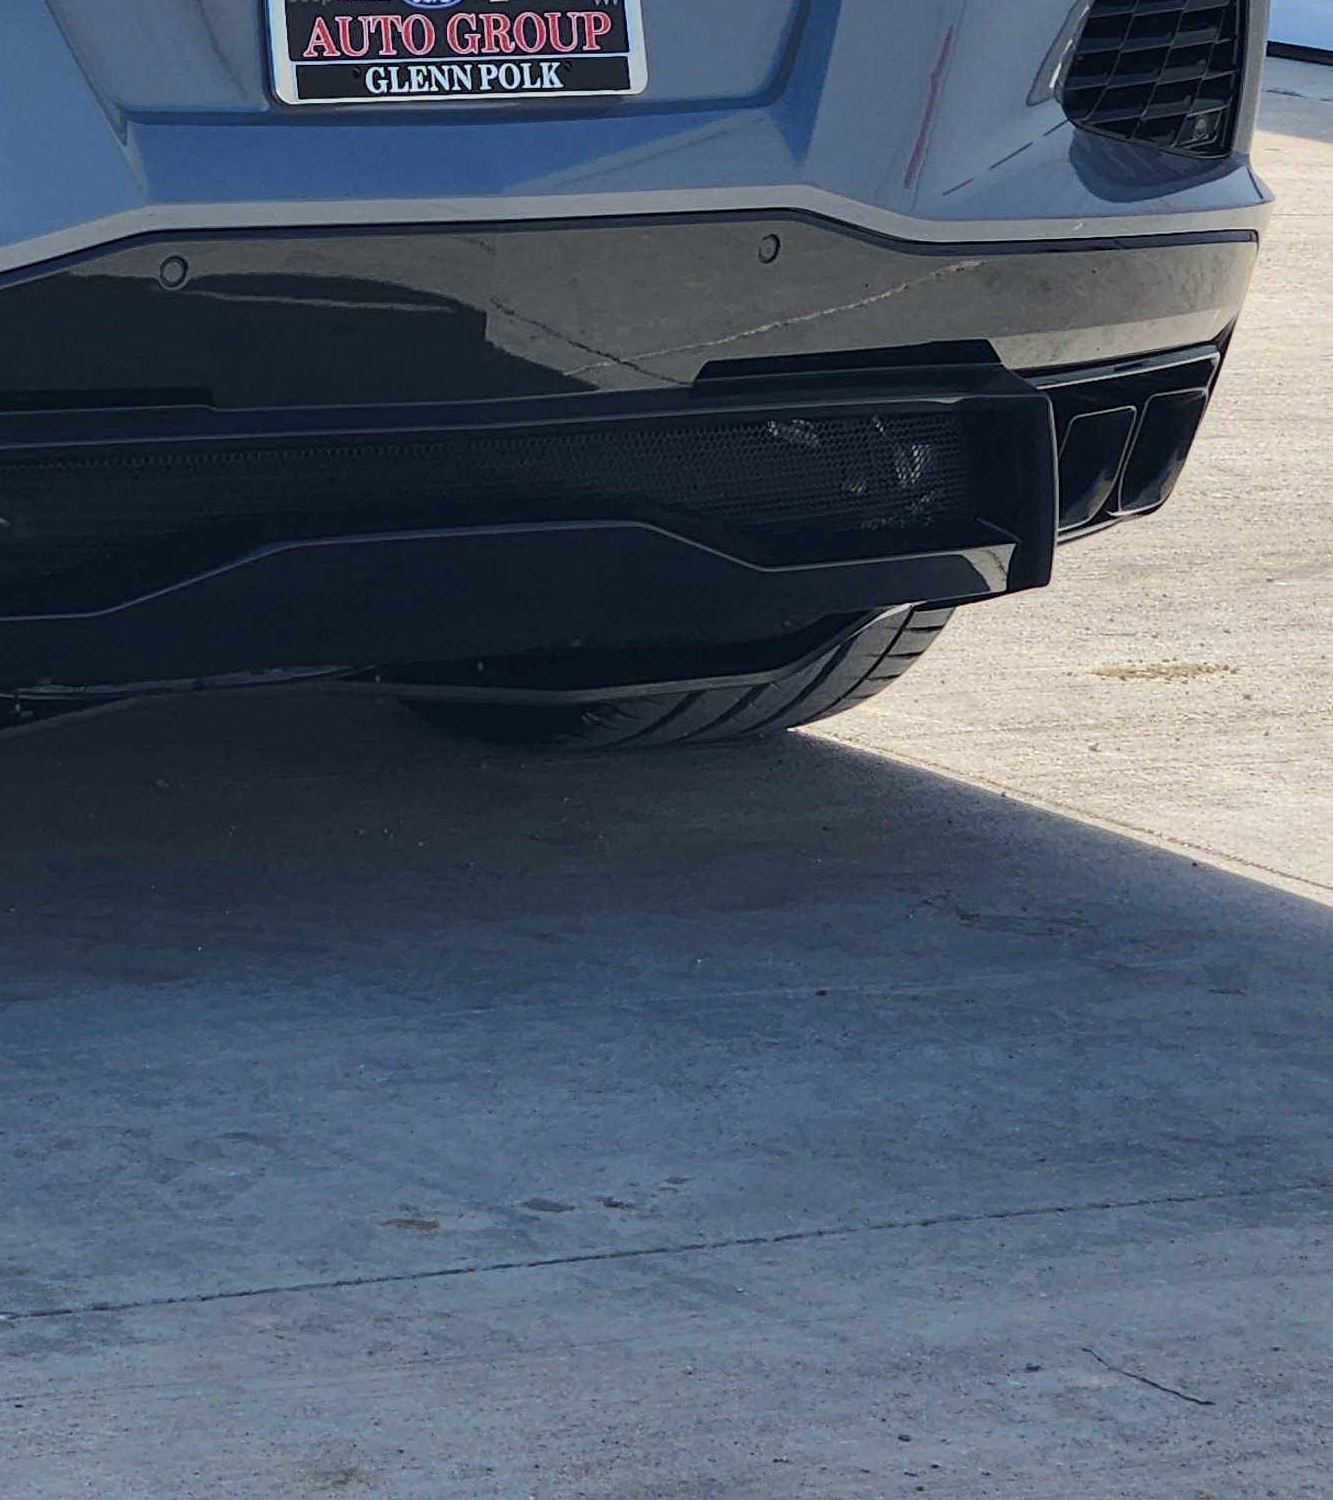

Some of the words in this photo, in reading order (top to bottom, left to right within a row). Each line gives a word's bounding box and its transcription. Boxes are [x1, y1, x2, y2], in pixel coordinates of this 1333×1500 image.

[303, 14, 435, 57] AUTO
[446, 11, 612, 55] GROUP
[365, 64, 472, 93] GLENN
[478, 62, 564, 90] POLK
